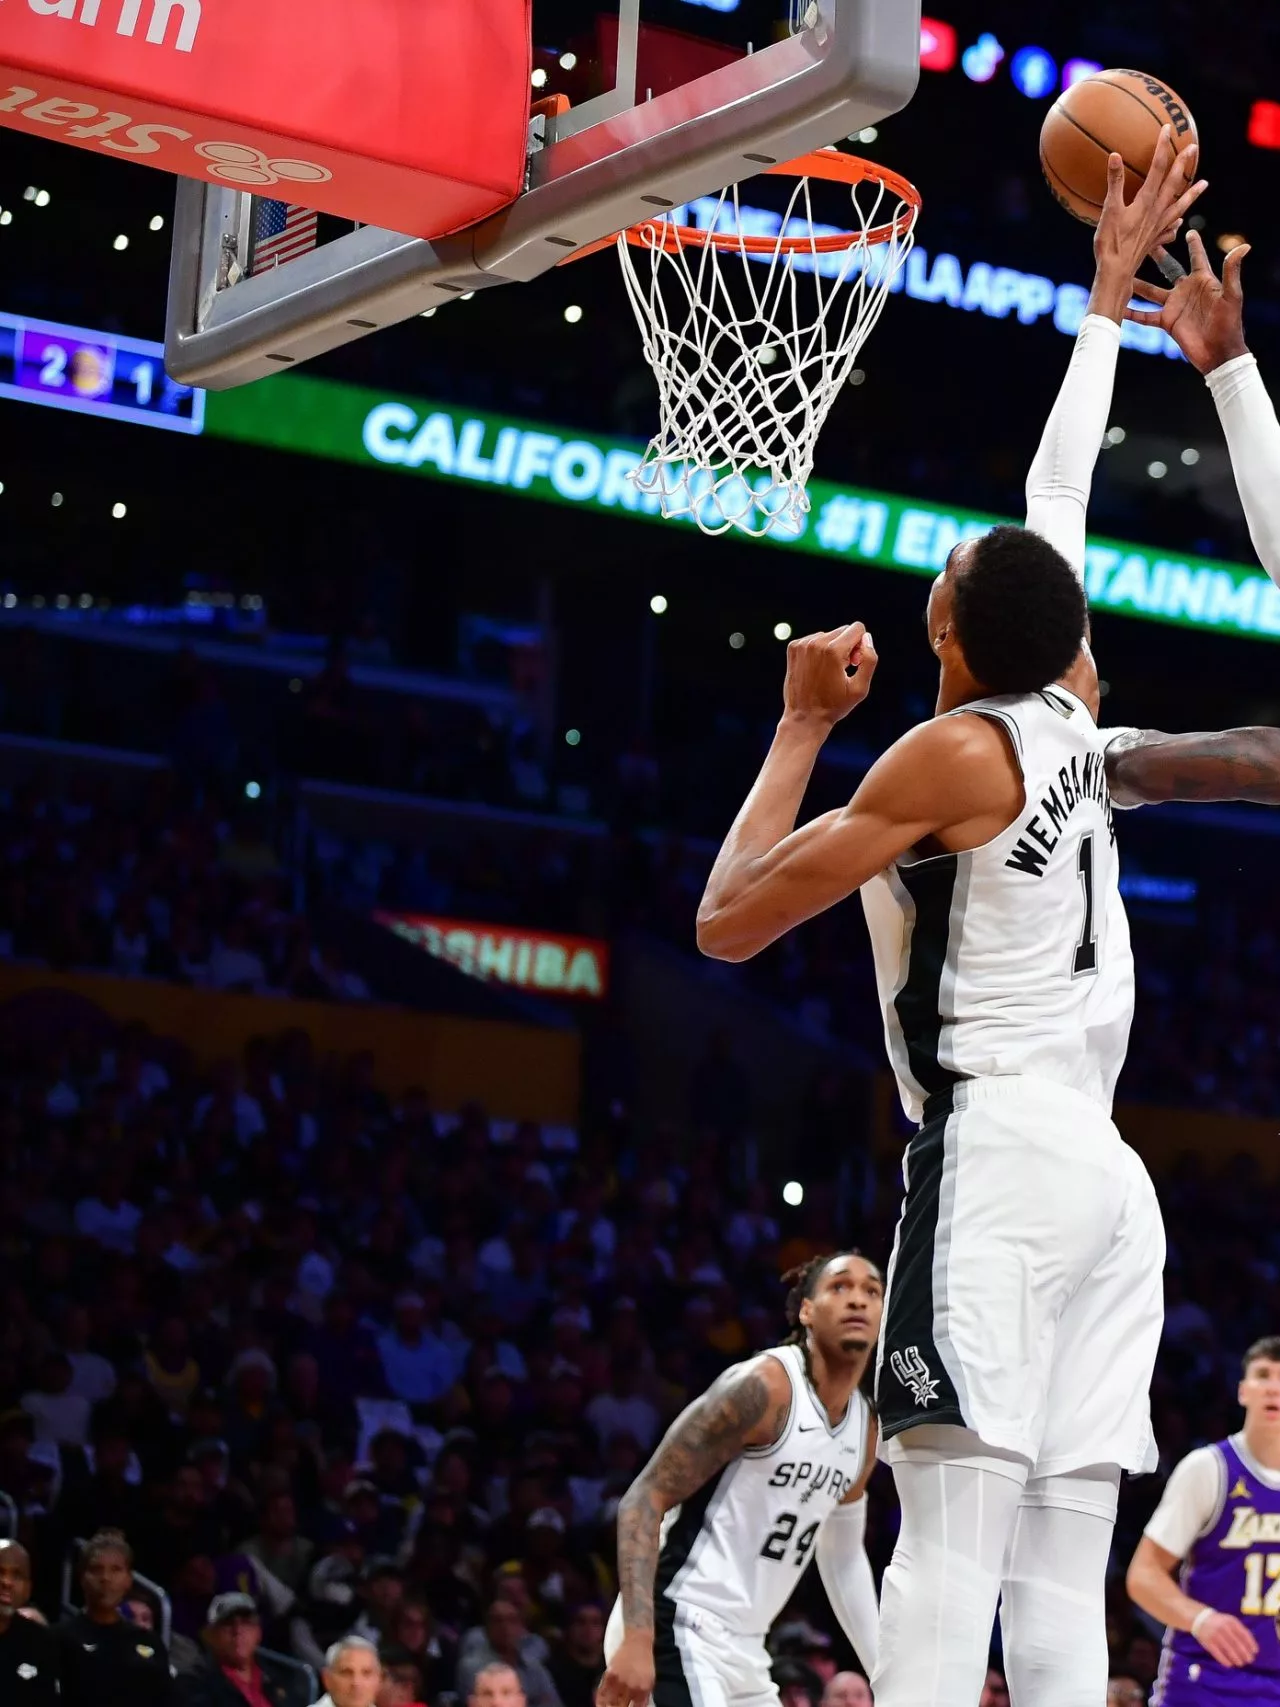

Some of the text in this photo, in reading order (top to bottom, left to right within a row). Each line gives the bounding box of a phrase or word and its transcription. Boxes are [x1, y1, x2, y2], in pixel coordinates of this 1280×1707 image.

[962, 261, 1056, 326] APP
[39, 344, 68, 388] 2
[130, 360, 153, 405] 1
[814, 493, 889, 559] #1
[1070, 828, 1099, 981] 1
[760, 1511, 821, 1567] 24
